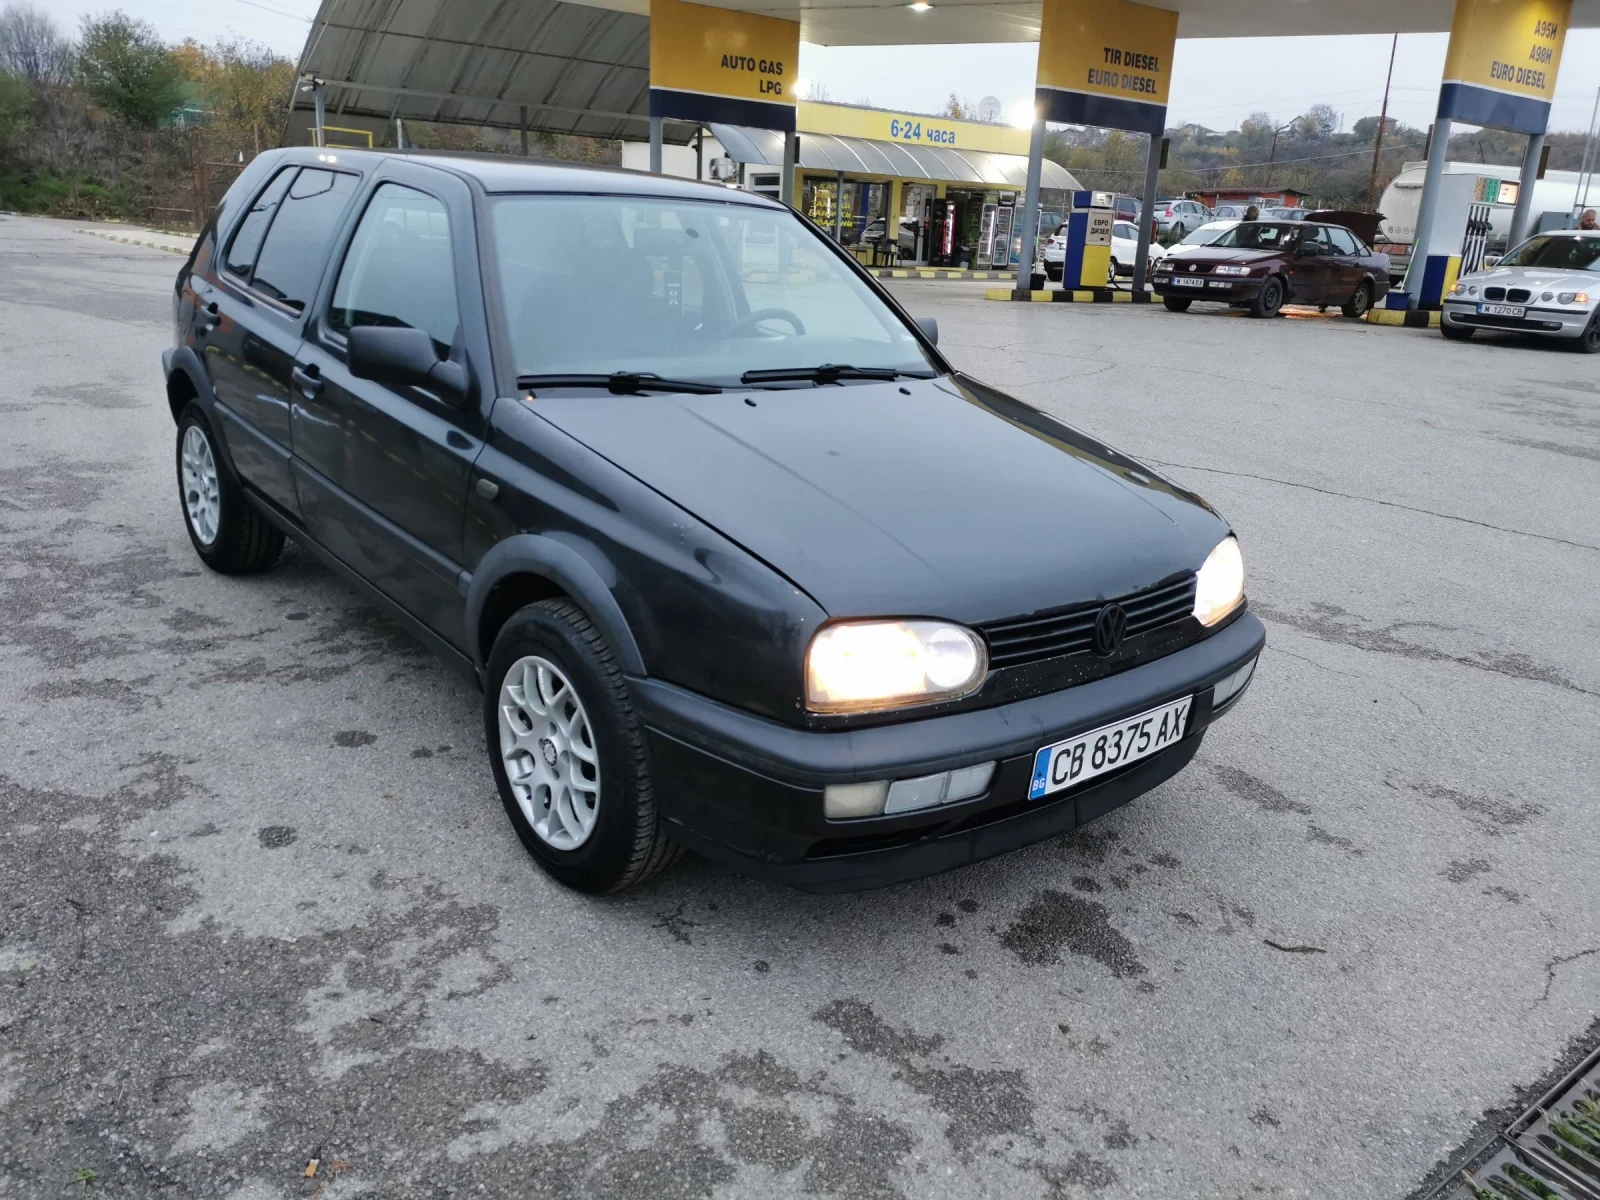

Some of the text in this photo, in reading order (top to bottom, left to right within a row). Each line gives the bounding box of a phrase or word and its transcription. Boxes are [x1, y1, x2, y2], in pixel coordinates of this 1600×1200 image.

[721, 54, 783, 76] AUTO GAS
[1103, 47, 1160, 72] TIR DIESEL
[759, 80, 782, 95] LPG
[1087, 68, 1157, 94] EURO DIESEL
[1490, 61, 1546, 90] EURO DIESEL
[891, 119, 956, 144] 6-24 часа
[1494, 306, 1511, 315] 1270
[1512, 308, 1523, 316] CB
[1051, 704, 1188, 786] CB 8375 AX
[1032, 777, 1046, 791] BG
